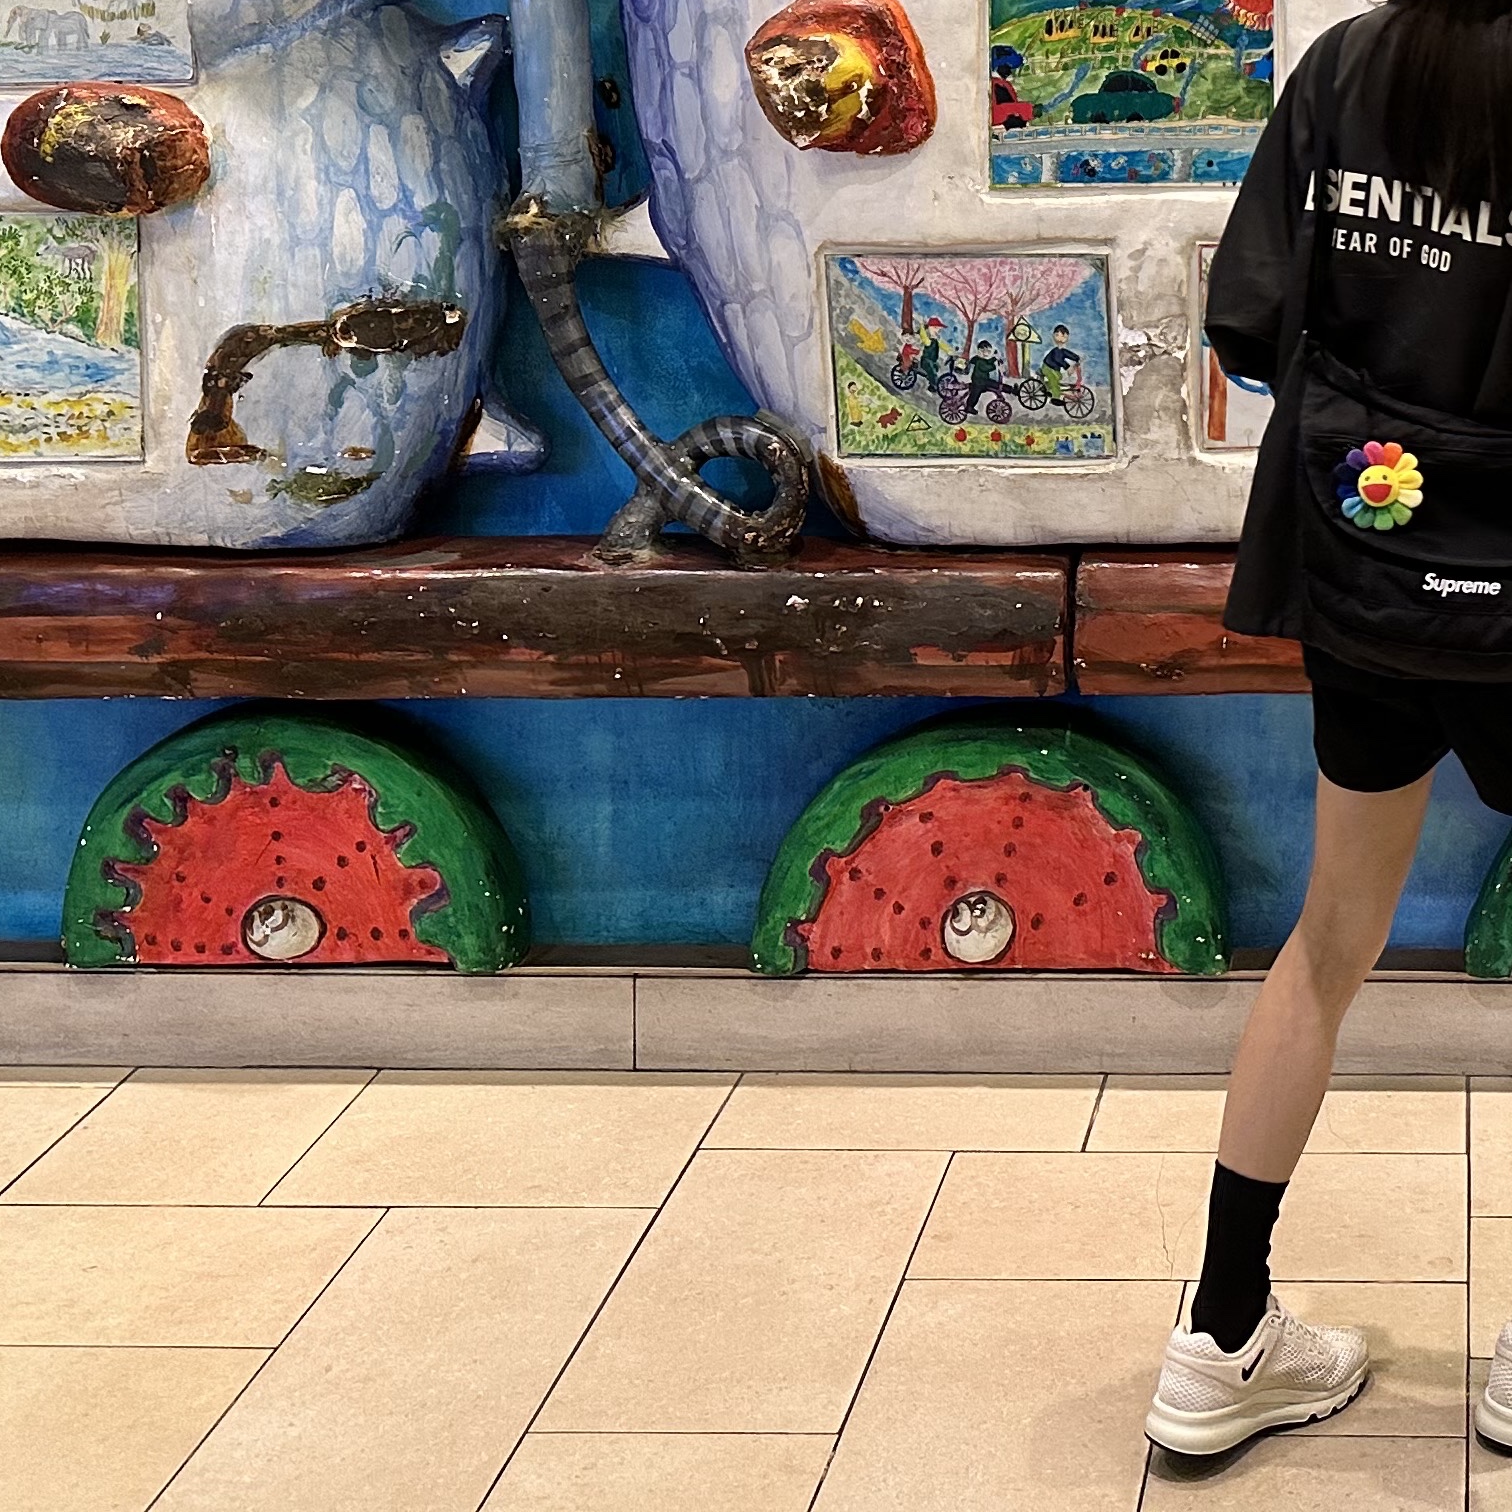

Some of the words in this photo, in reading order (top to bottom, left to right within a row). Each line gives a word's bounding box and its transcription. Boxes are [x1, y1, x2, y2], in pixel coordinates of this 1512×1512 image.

[1331, 227, 1378, 254] EAR
[1389, 236, 1413, 259] OF
[1420, 243, 1452, 273] GOD
[1422, 572, 1502, 598] Supreme
